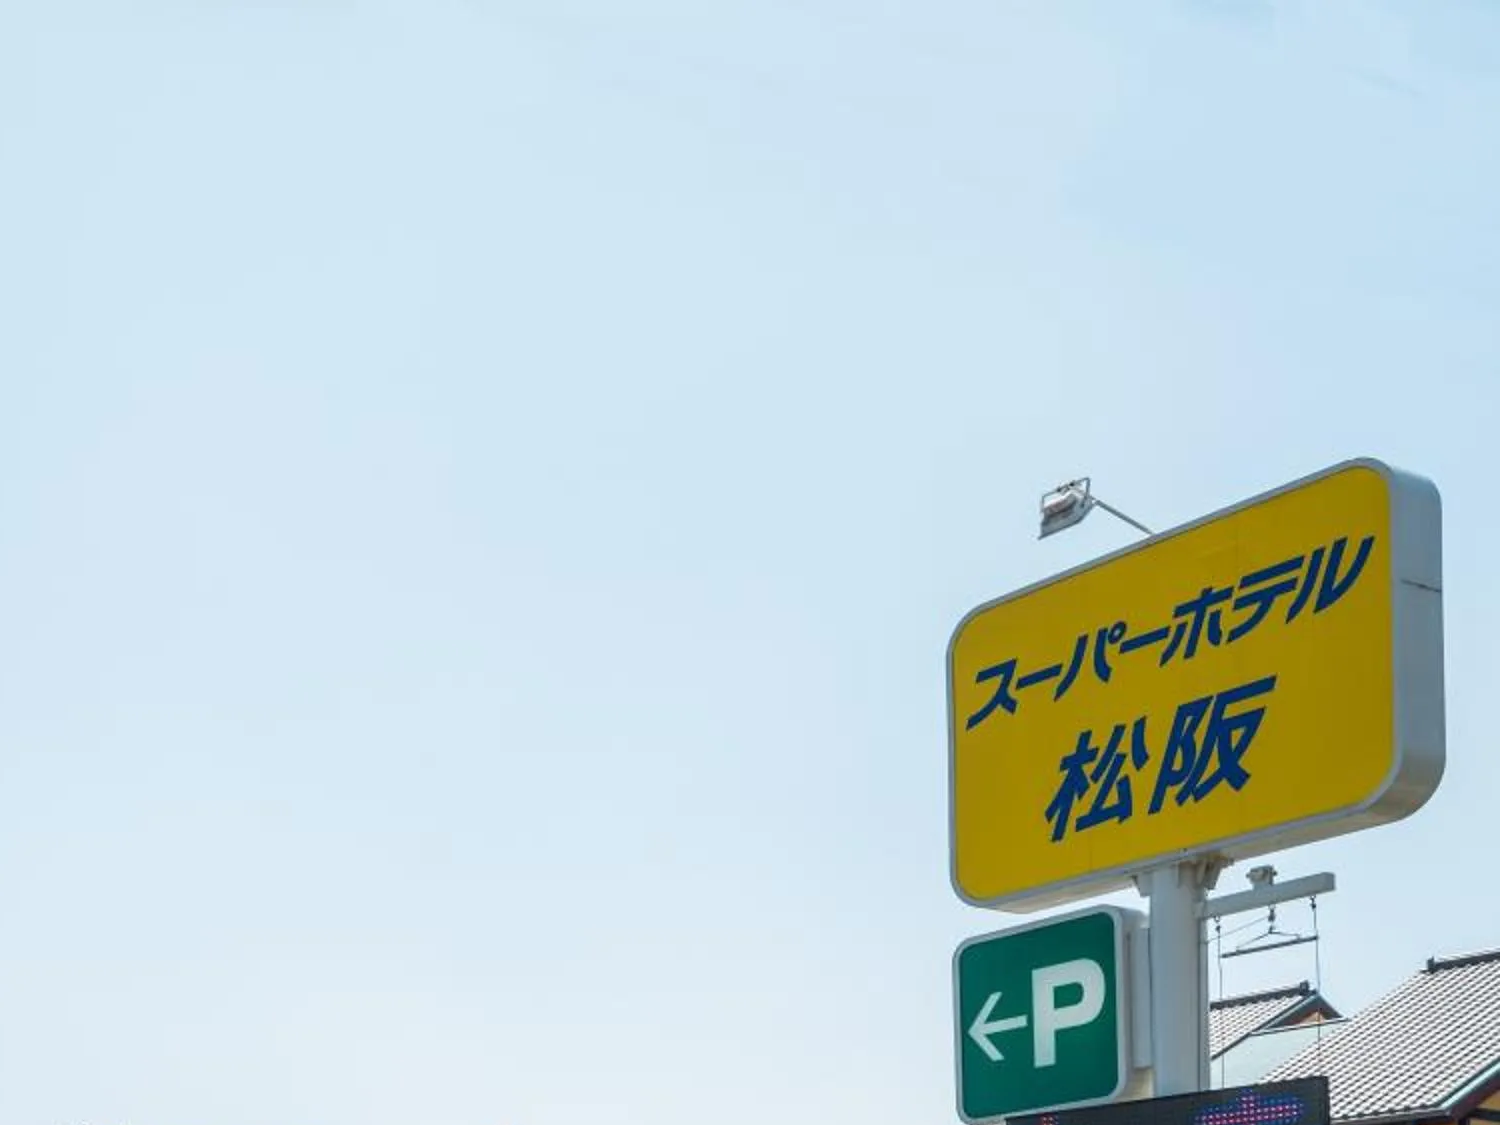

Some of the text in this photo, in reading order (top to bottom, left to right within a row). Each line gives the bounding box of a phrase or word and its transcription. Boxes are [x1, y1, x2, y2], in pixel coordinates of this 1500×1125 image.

[966, 535, 1376, 731] スーパーホテル
[1044, 675, 1278, 842] 松阪
[1032, 957, 1106, 1068] P
